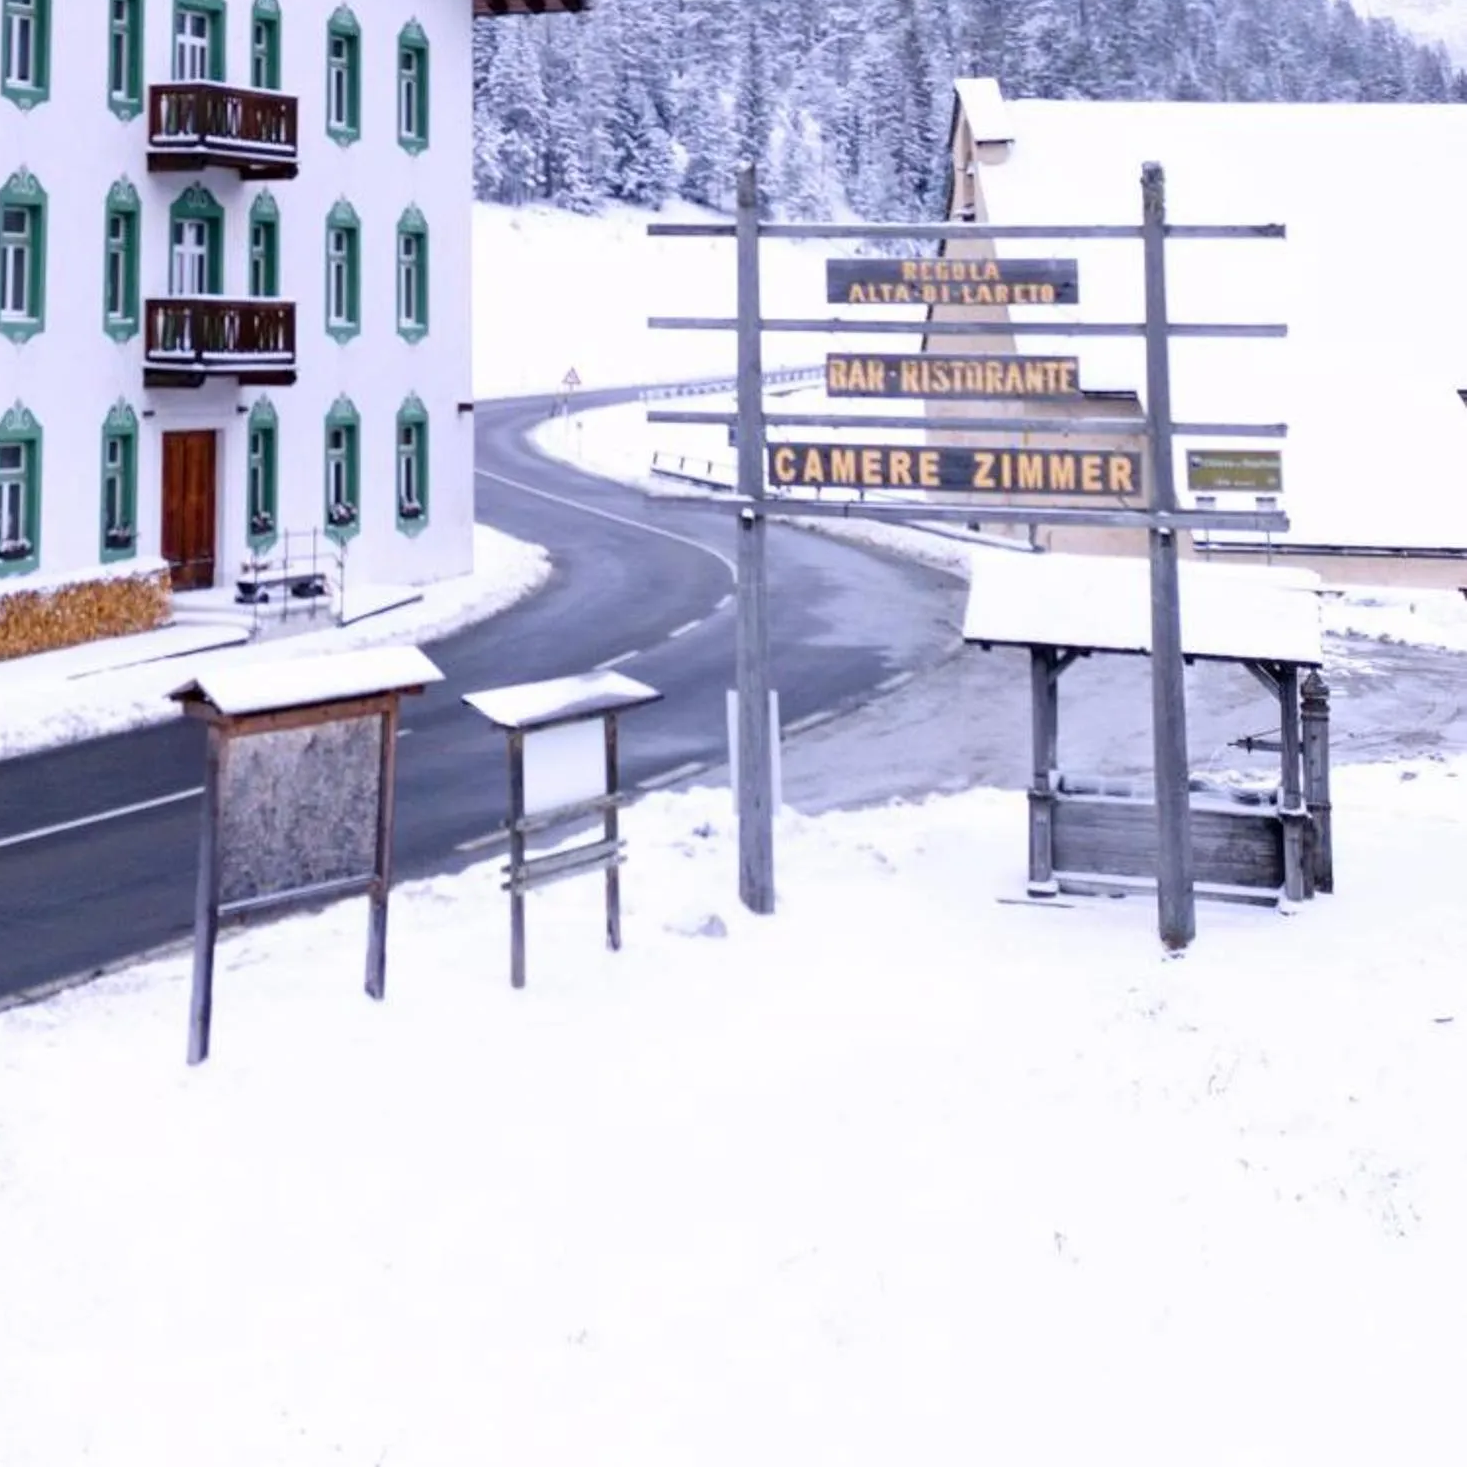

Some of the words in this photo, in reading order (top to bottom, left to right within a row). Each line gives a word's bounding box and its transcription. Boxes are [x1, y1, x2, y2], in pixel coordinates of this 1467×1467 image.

[901, 260, 1001, 281] REGOLA
[848, 283, 911, 303] ALTA
[829, 359, 885, 391] BAR
[900, 360, 1077, 394] RISTORANTE
[774, 446, 942, 486] CAMERE
[973, 452, 1134, 491] ZIMMER
